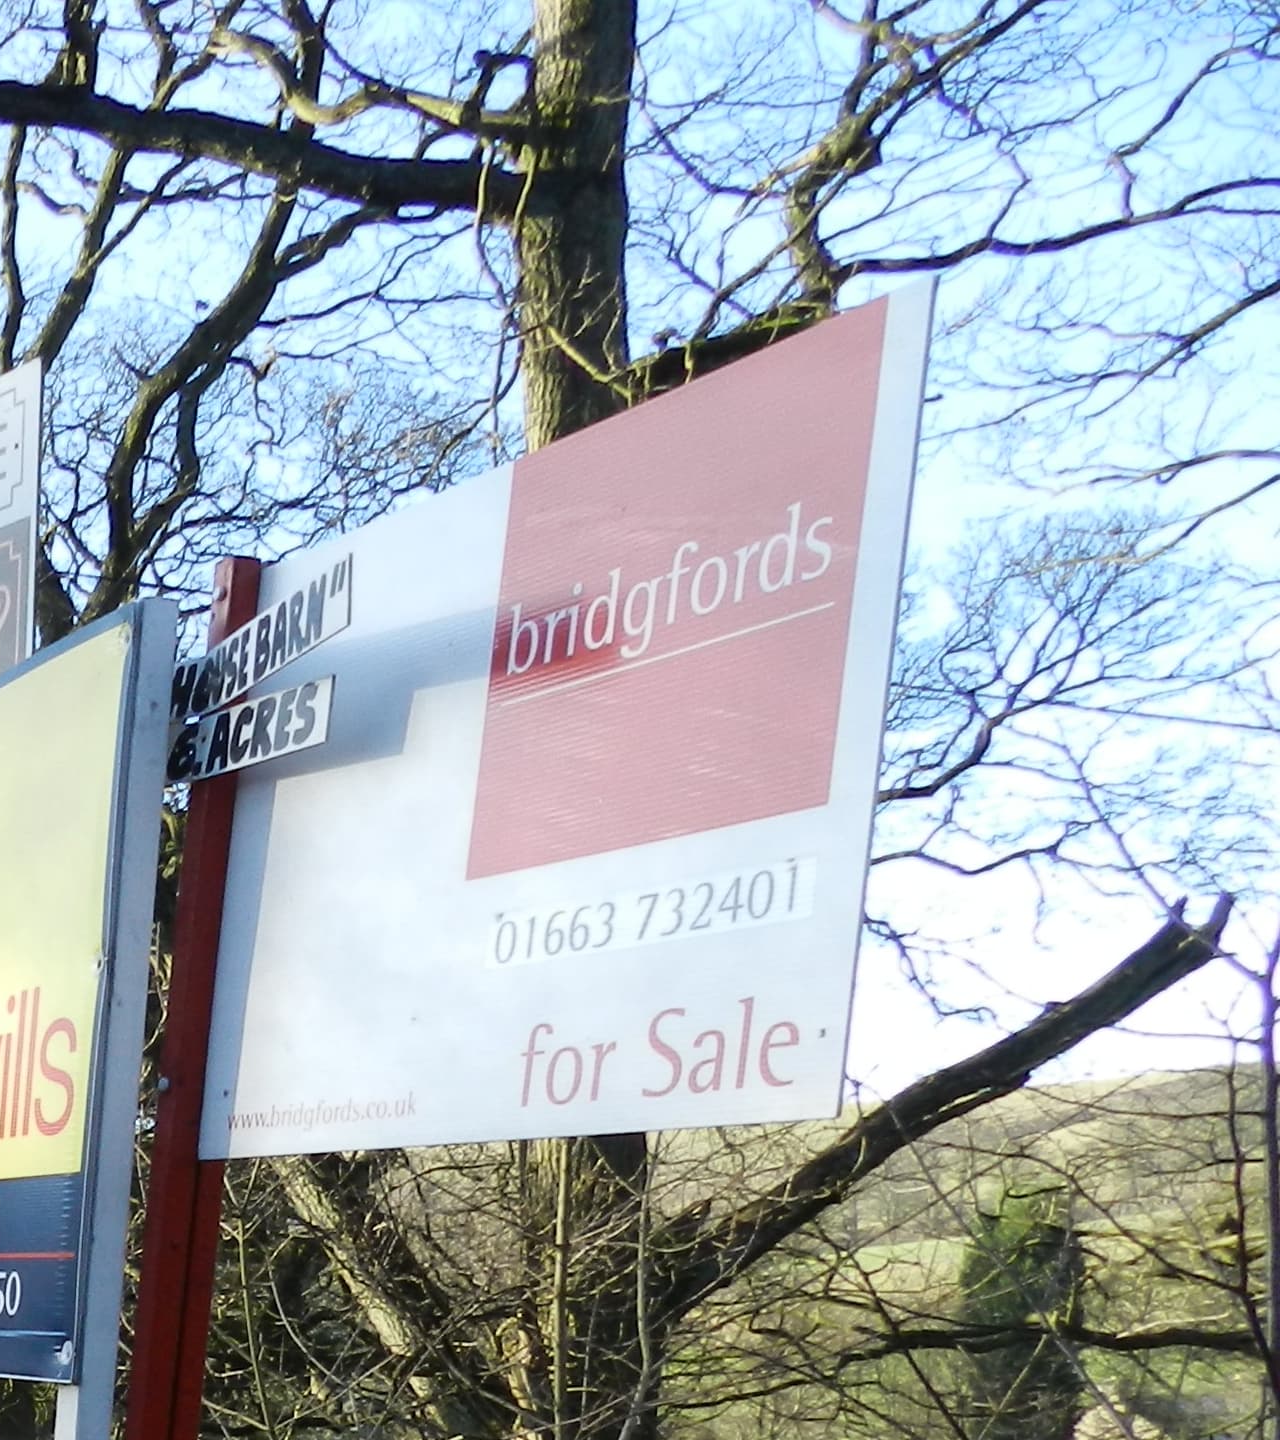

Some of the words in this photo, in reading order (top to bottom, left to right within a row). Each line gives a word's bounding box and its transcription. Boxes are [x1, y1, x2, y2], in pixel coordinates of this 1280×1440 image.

[506, 500, 834, 676] bridgfords
[206, 681, 320, 775] ACRES
[494, 901, 616, 964] 01663
[636, 859, 800, 941] 732401
[520, 1022, 617, 1107] for
[641, 995, 800, 1098] Sale
[227, 1090, 417, 1132] www.bridgfords.co.uk
